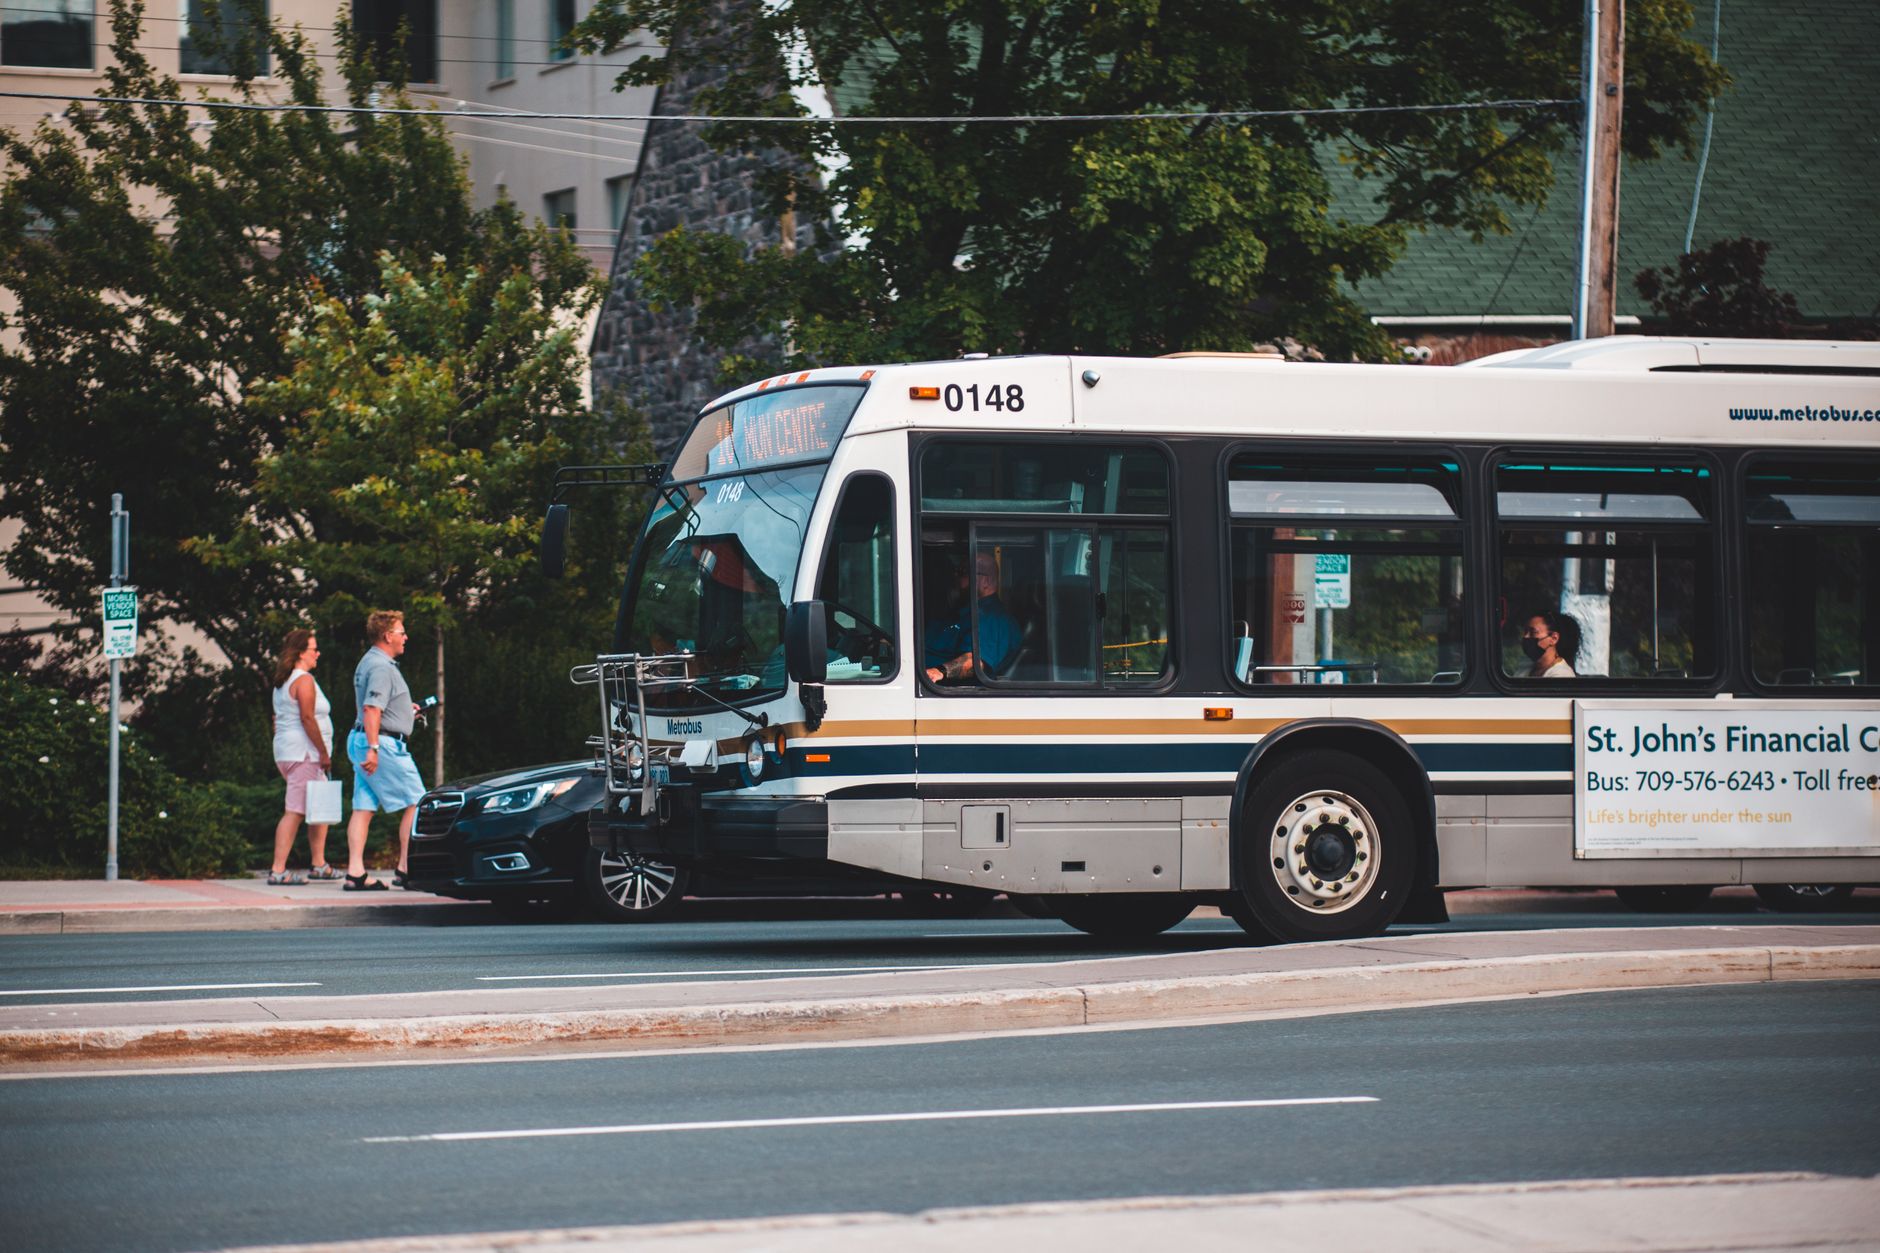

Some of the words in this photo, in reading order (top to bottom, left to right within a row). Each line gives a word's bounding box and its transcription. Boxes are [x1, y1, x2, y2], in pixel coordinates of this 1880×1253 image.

[944, 384, 1024, 412] 0148
[743, 412, 773, 463] MUN
[775, 403, 828, 456] CENTRE
[717, 481, 744, 504] 0148
[107, 601, 134, 610] VENDOR
[110, 610, 132, 618] SPACE
[667, 718, 702, 735] Metrobus
[1587, 726, 1623, 752] St.
[1630, 723, 1716, 757] John's
[1726, 724, 1850, 752] Financial
[1860, 726, 1880, 752] C
[1587, 772, 1628, 791] Bus:
[1636, 770, 1774, 791] 709-576-6243
[1793, 770, 1830, 790] Toll
[1588, 810, 1624, 824] Life's
[1628, 809, 1686, 827] brighter
[1692, 810, 1732, 824] under
[1738, 810, 1762, 823] the
[1768, 812, 1792, 822] sun
